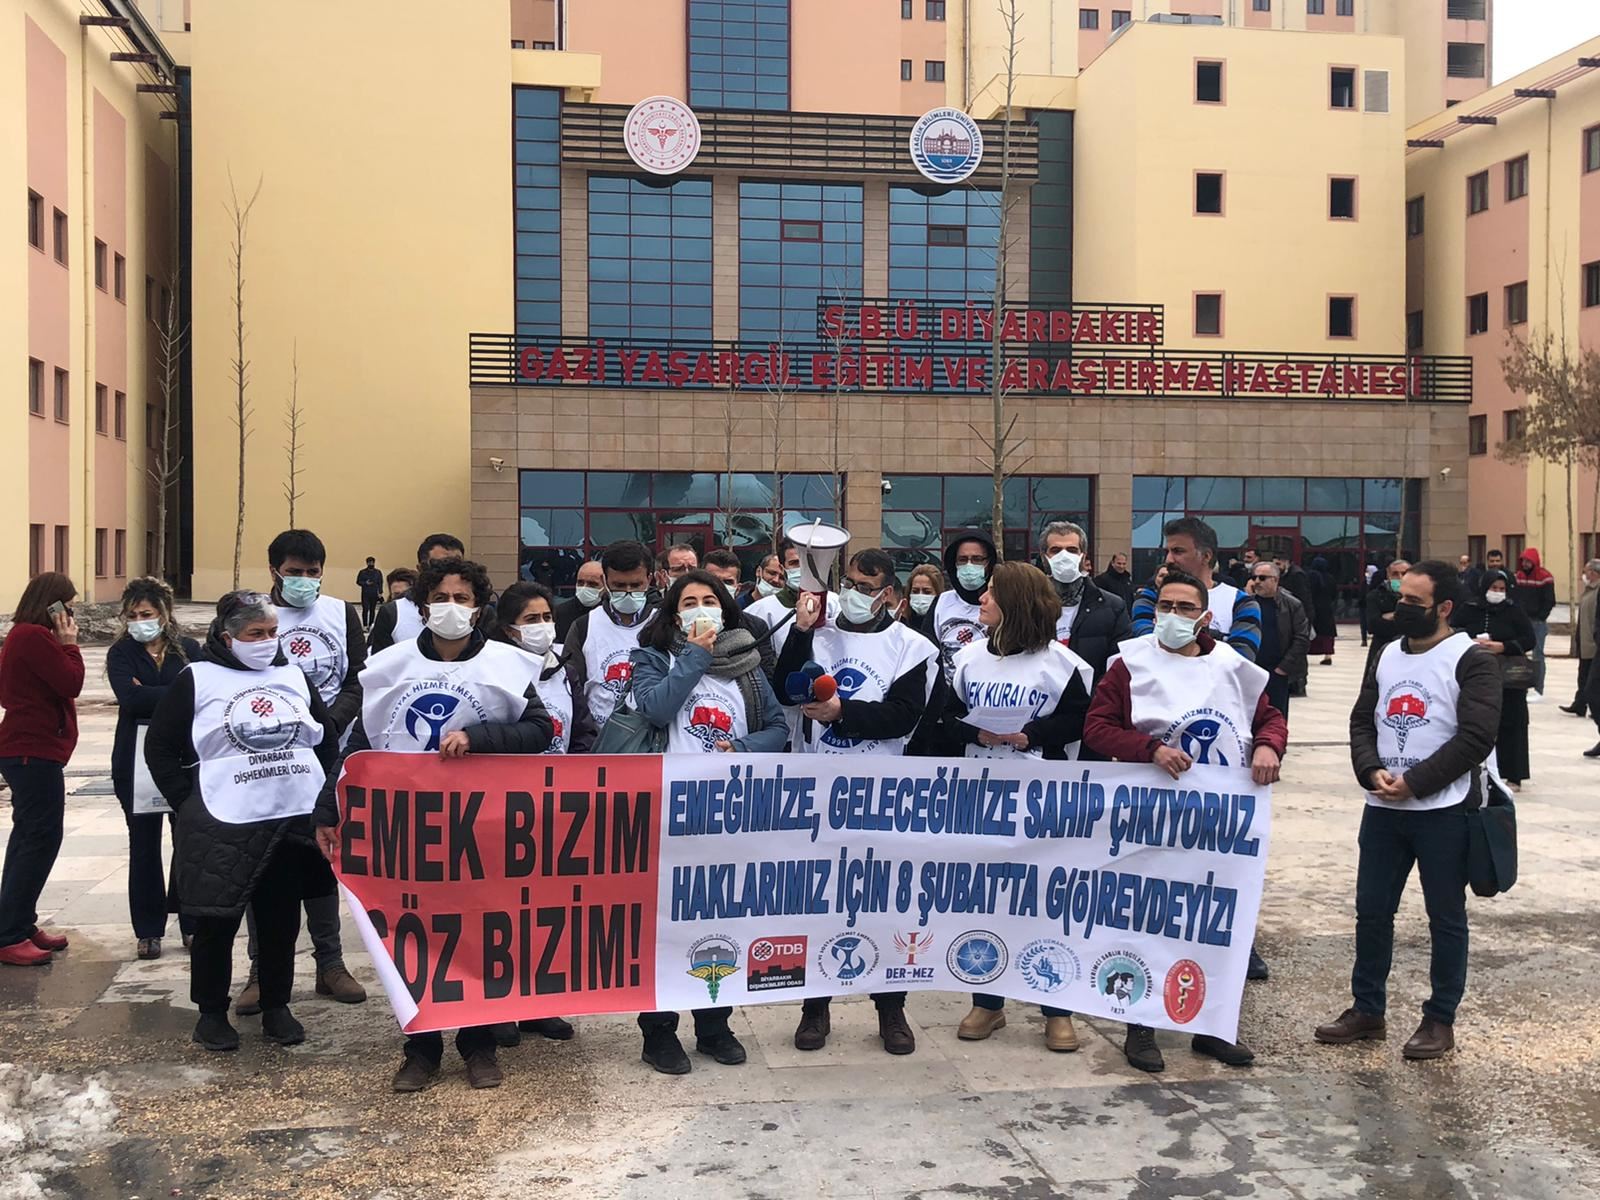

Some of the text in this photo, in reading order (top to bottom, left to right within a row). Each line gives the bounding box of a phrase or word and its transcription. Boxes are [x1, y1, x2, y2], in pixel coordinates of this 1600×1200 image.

[941, 301, 1160, 344] DİYARBAKIR
[520, 339, 1421, 397] GAZİ YAŞARGİL EĞİTİM VE ARAŞTIRMA HASTANESİ
[1163, 720, 1181, 742] OSYAL
[234, 763, 290, 784] DİŞHEKİMLERİ
[340, 766, 651, 882] EMEK BİZİM
[668, 764, 821, 843] EMEĞİMİZE,
[828, 766, 1020, 837] GELECEĞİMİZE
[1024, 769, 1105, 839] SAHİP
[671, 859, 832, 921] HAKLARIMIZ
[836, 846, 892, 928] İÇİN
[895, 860, 914, 913] 8
[917, 860, 1038, 927] ŞUBAT'TA
[483, 884, 642, 1000] BİZİM!
[774, 943, 804, 956] TDB
[886, 968, 935, 979] DER-MEZ
